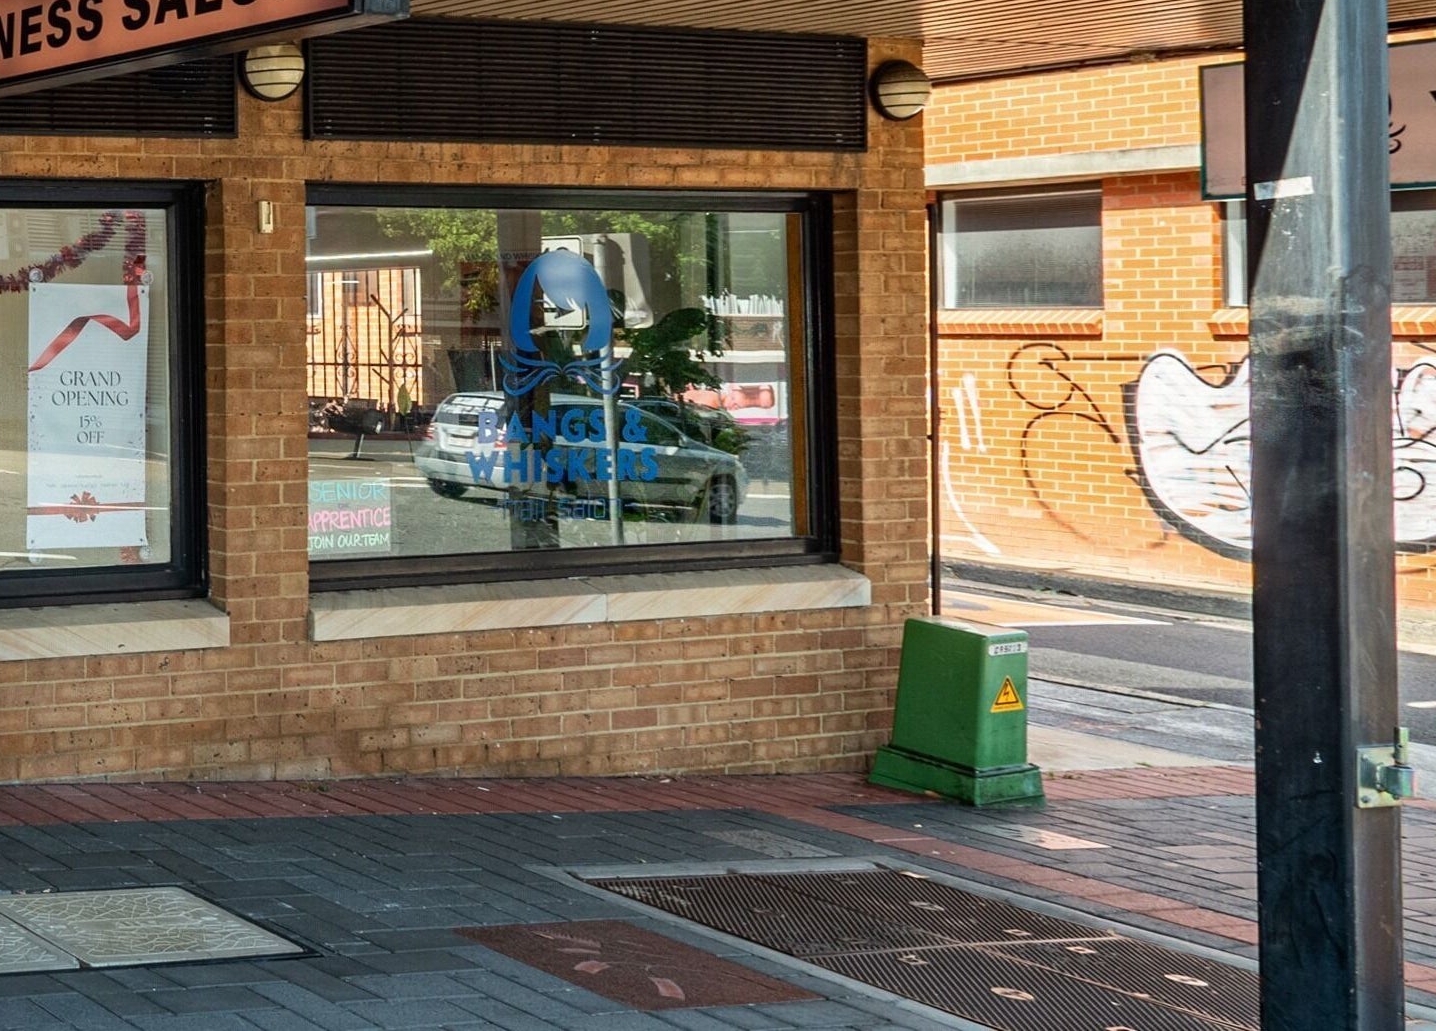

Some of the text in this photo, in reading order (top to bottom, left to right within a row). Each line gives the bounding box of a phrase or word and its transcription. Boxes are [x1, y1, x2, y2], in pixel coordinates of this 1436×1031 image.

[59, 371, 121, 386] GRAND
[51, 390, 129, 406] OPENING
[79, 415, 102, 428] 15%
[478, 408, 649, 444] BANGS &
[76, 431, 104, 444] OFF
[466, 447, 660, 485] WHISKERS
[310, 481, 389, 502] SENIOR
[308, 534, 334, 551] JOIN
